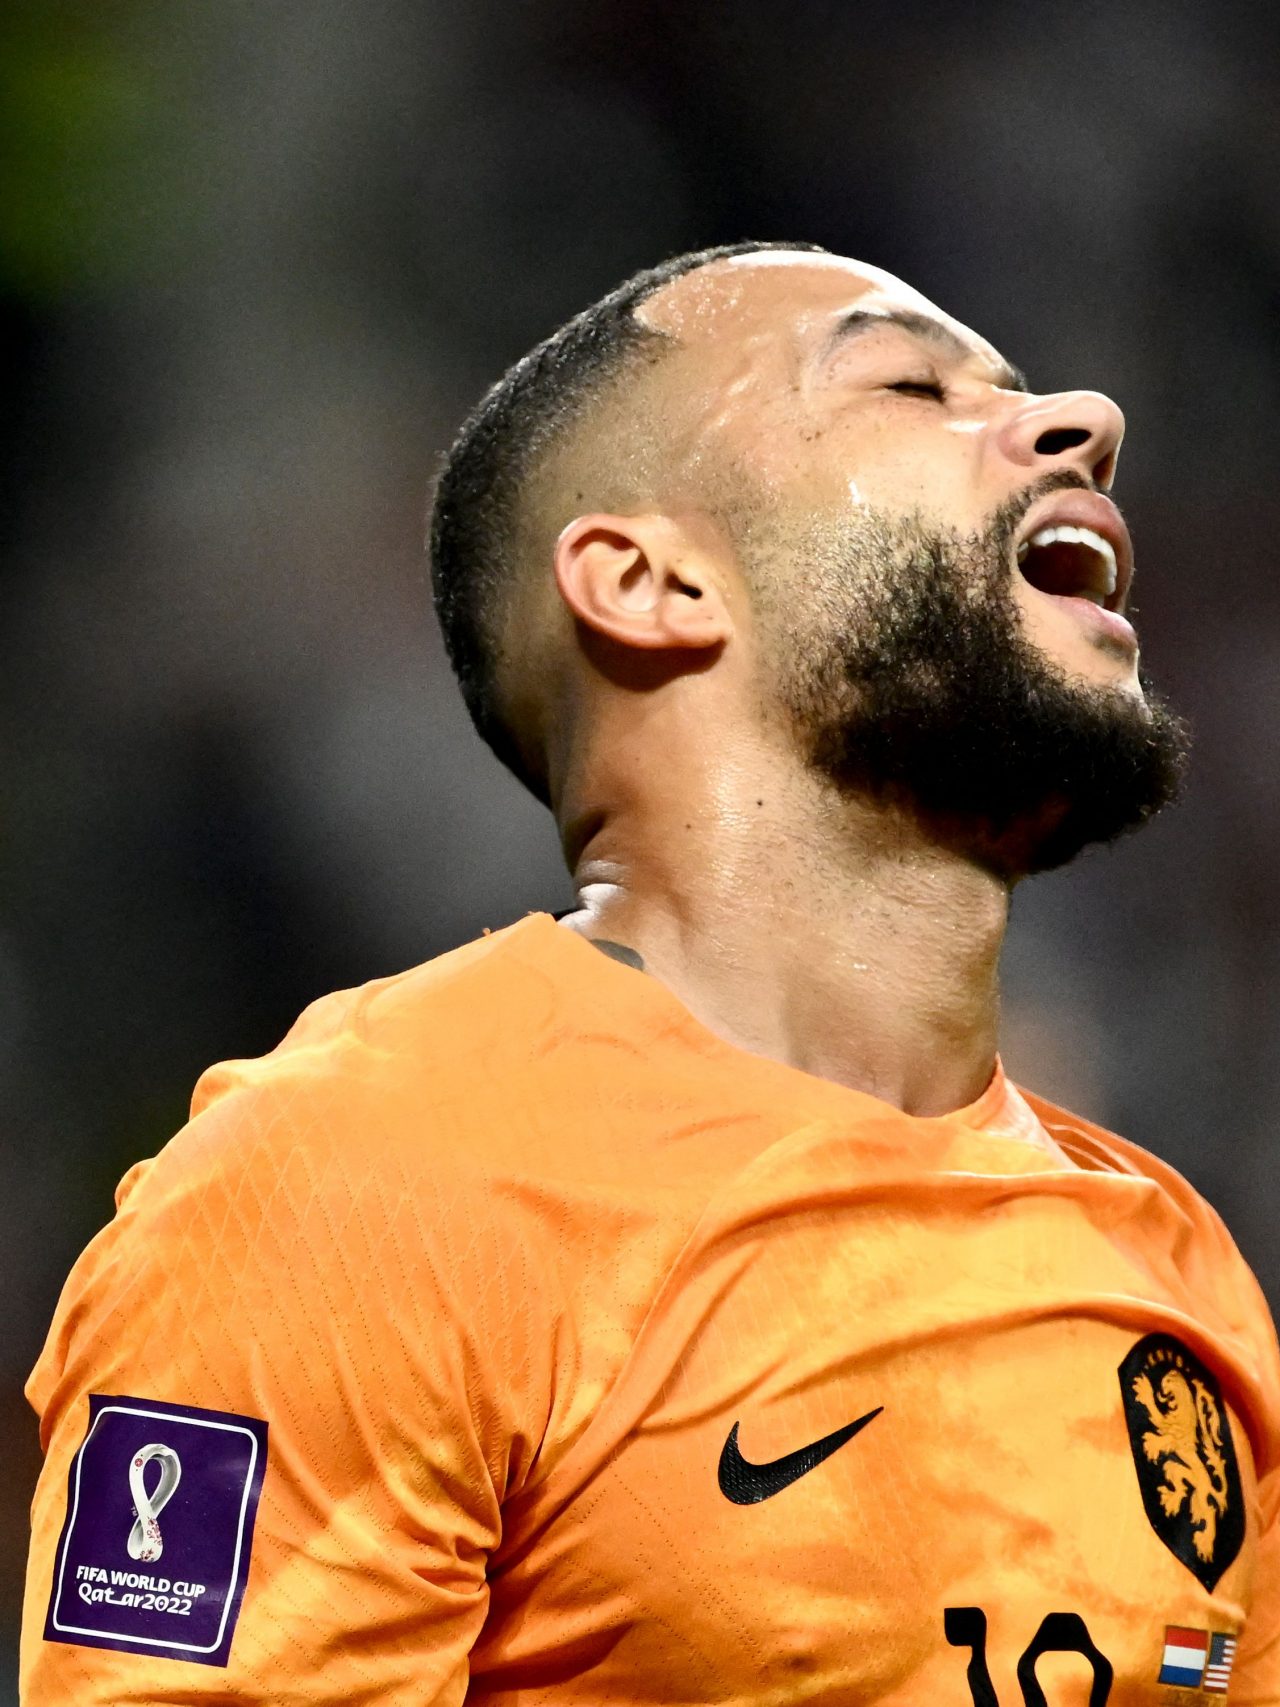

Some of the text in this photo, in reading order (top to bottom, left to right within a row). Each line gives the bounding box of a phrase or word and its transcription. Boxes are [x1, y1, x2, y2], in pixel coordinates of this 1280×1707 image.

[76, 1565, 206, 1598] FIFA WORLD CUP
